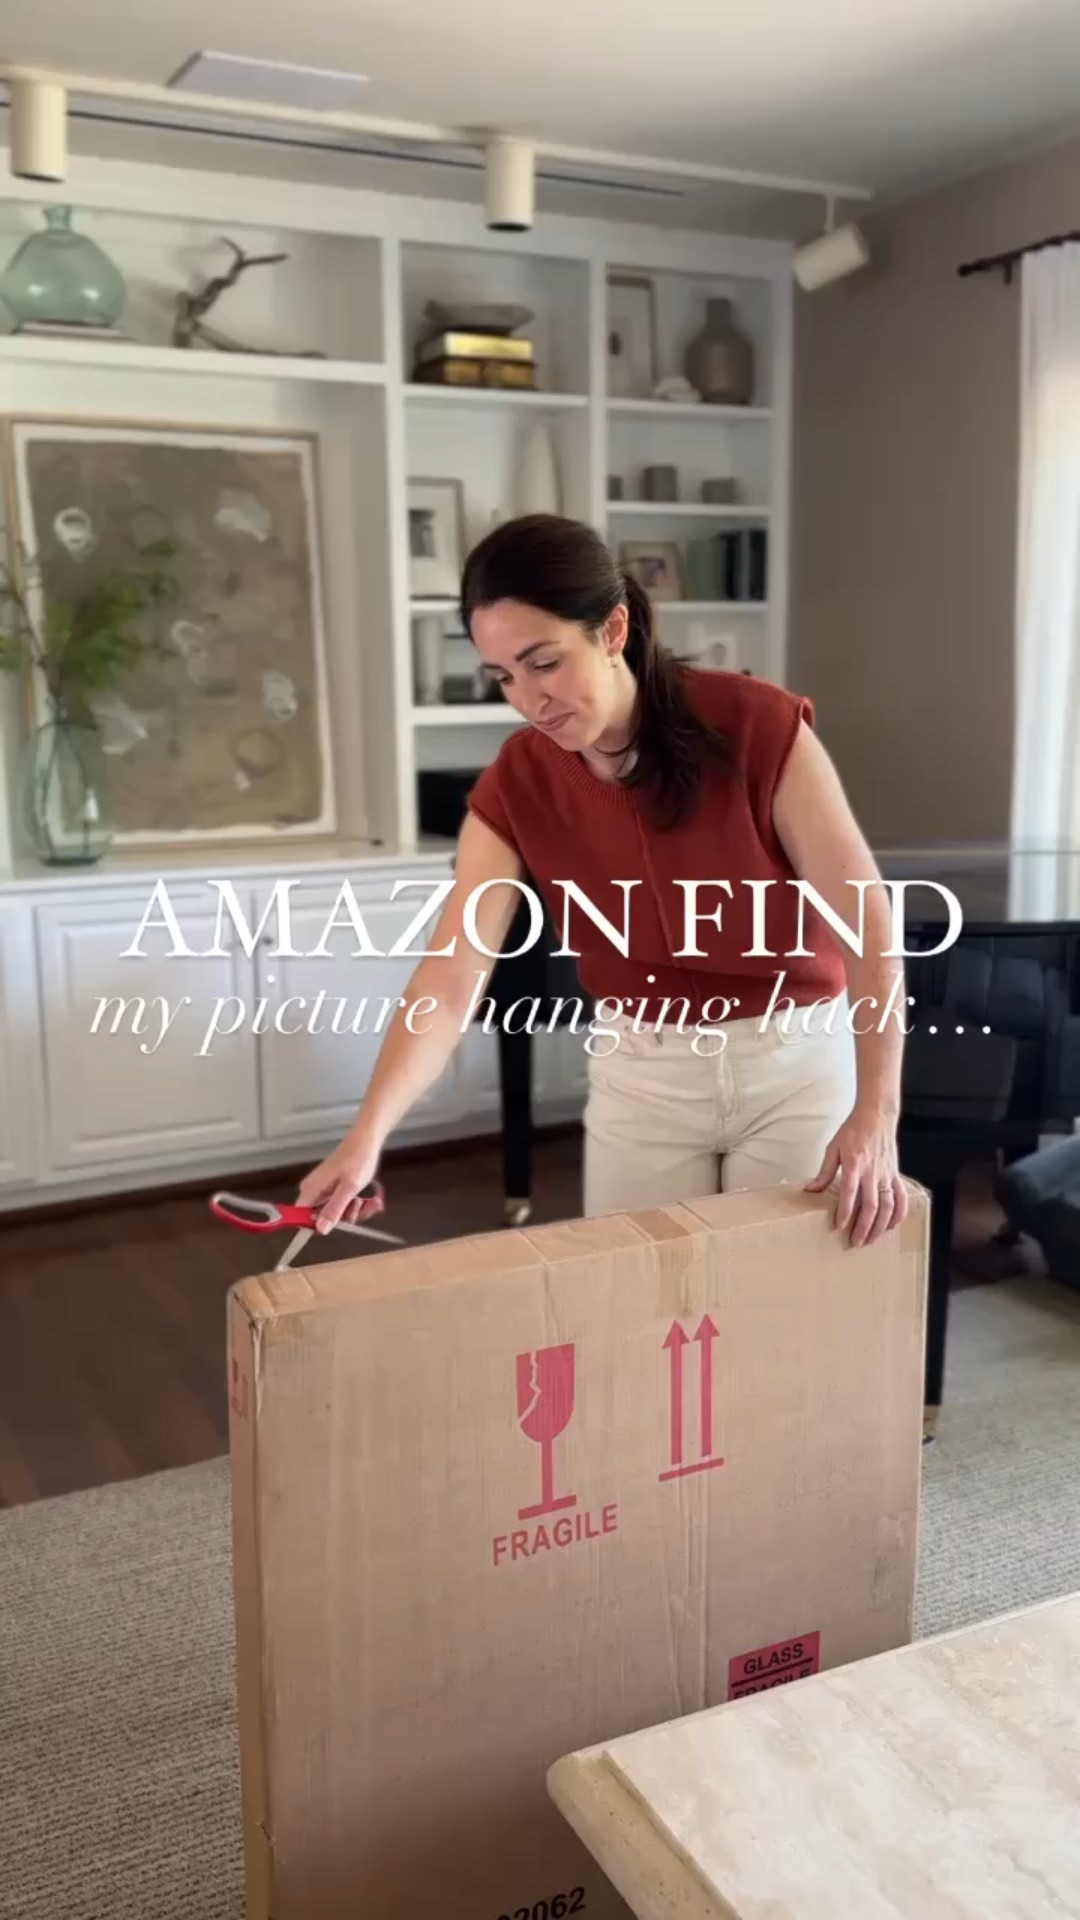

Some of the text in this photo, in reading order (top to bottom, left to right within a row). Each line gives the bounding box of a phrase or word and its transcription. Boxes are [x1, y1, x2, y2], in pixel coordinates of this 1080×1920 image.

[493, 1504, 618, 1567] FRAGILE
[743, 1642, 804, 1675] GLASS
[497, 1886, 587, 1920] 2062
